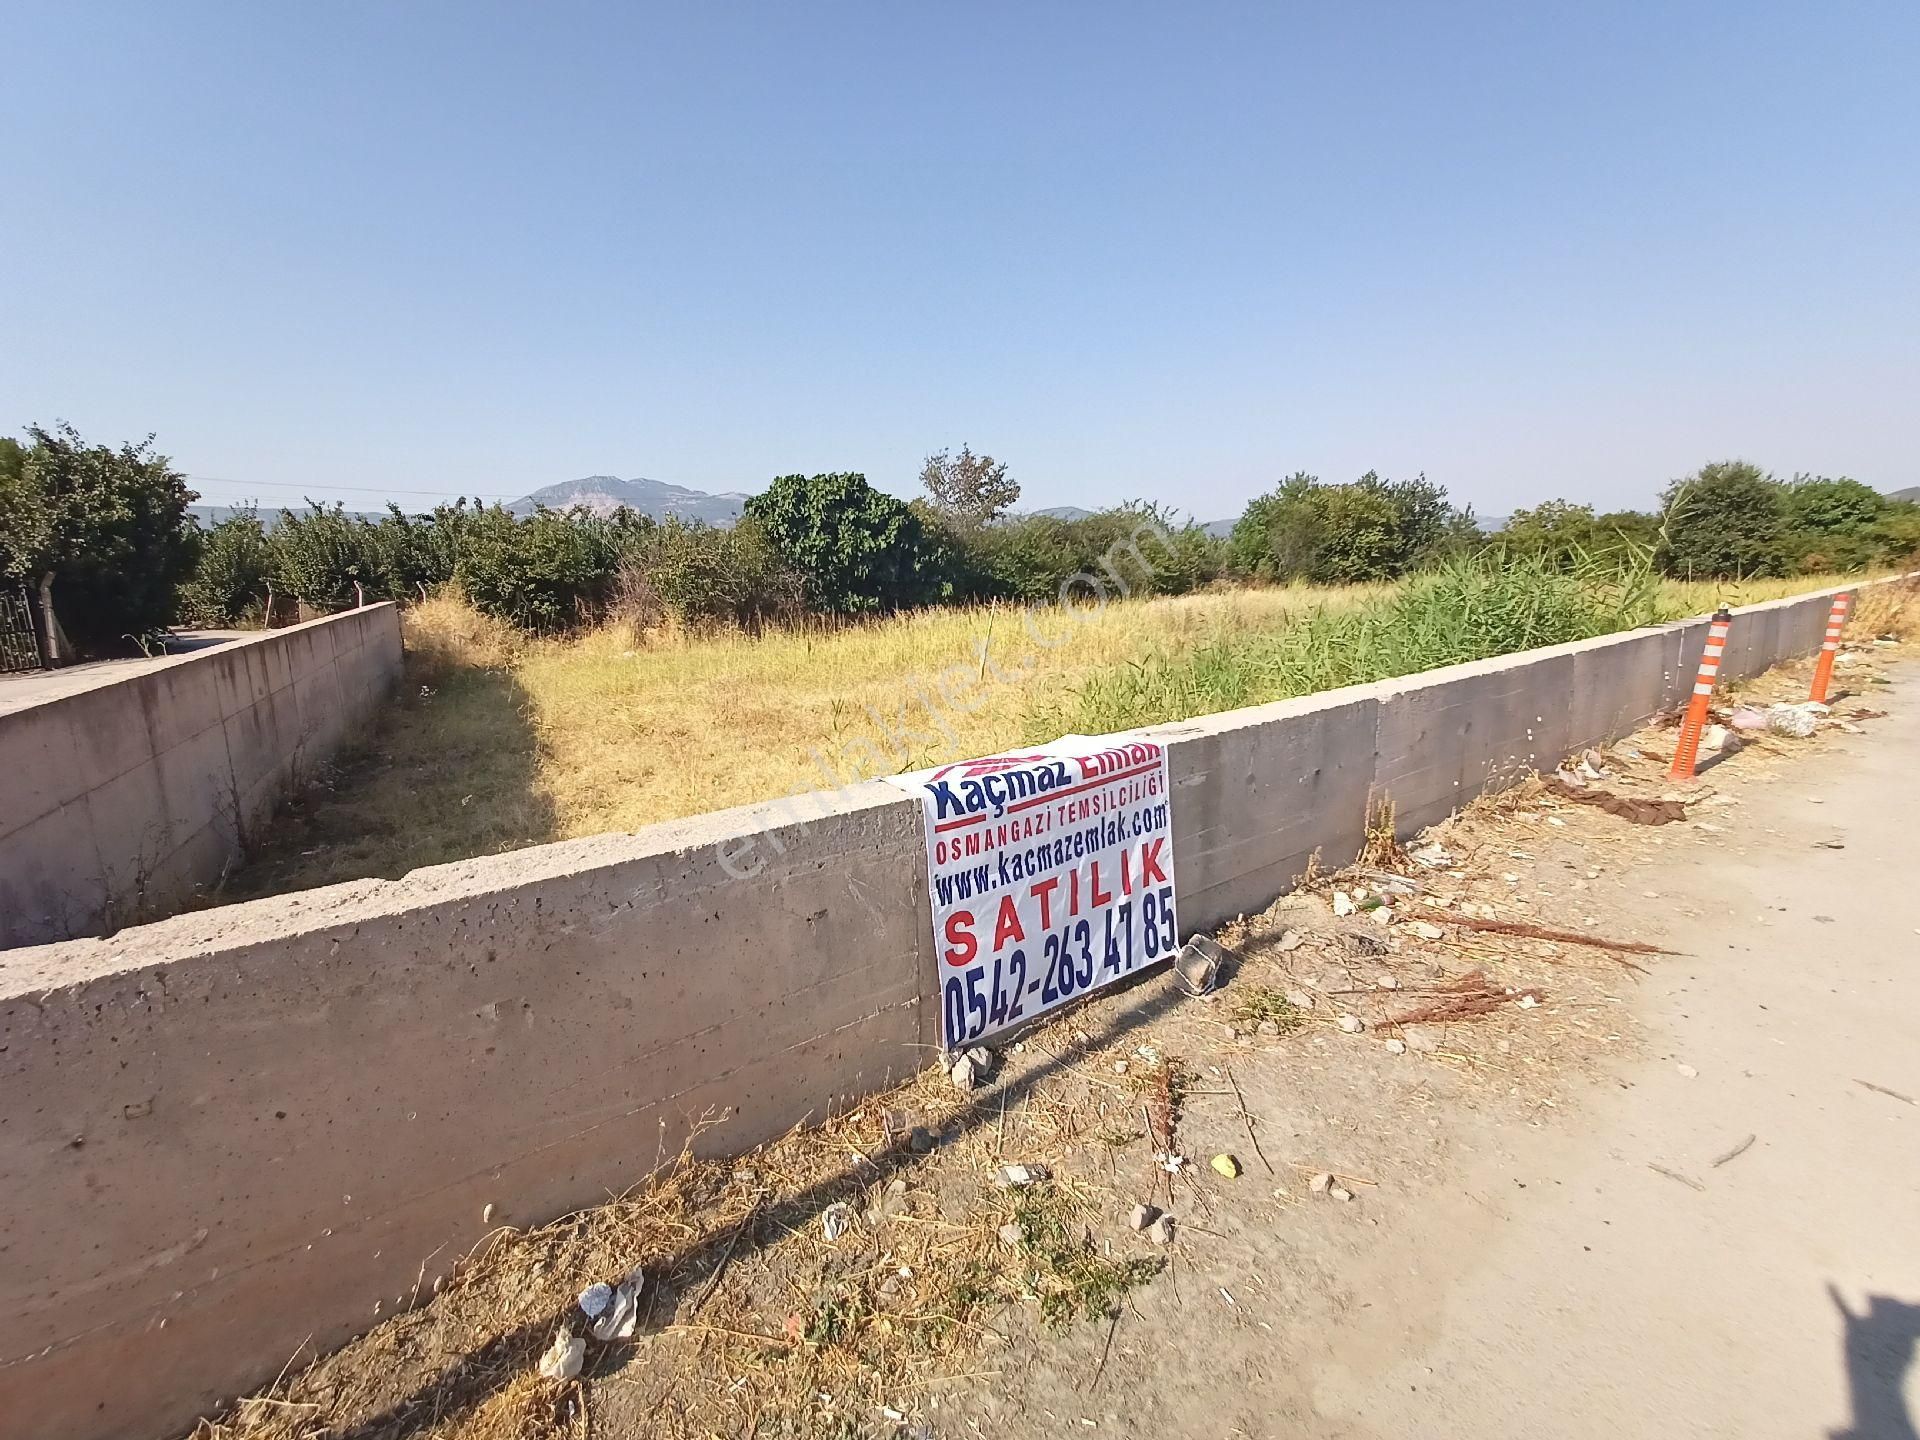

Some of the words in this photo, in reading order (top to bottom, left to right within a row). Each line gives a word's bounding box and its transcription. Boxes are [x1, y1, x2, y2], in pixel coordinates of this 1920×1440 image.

[923, 762, 1072, 820] Kaçmaz
[935, 806, 1051, 866] OSMANGAZİ
[934, 804, 1168, 906] www.kacmazemlak.com
[944, 837, 1168, 967] SATILIK
[945, 919, 1093, 1050] 0542-263
[1103, 901, 1133, 974] 47
[1142, 886, 1176, 959] 85
